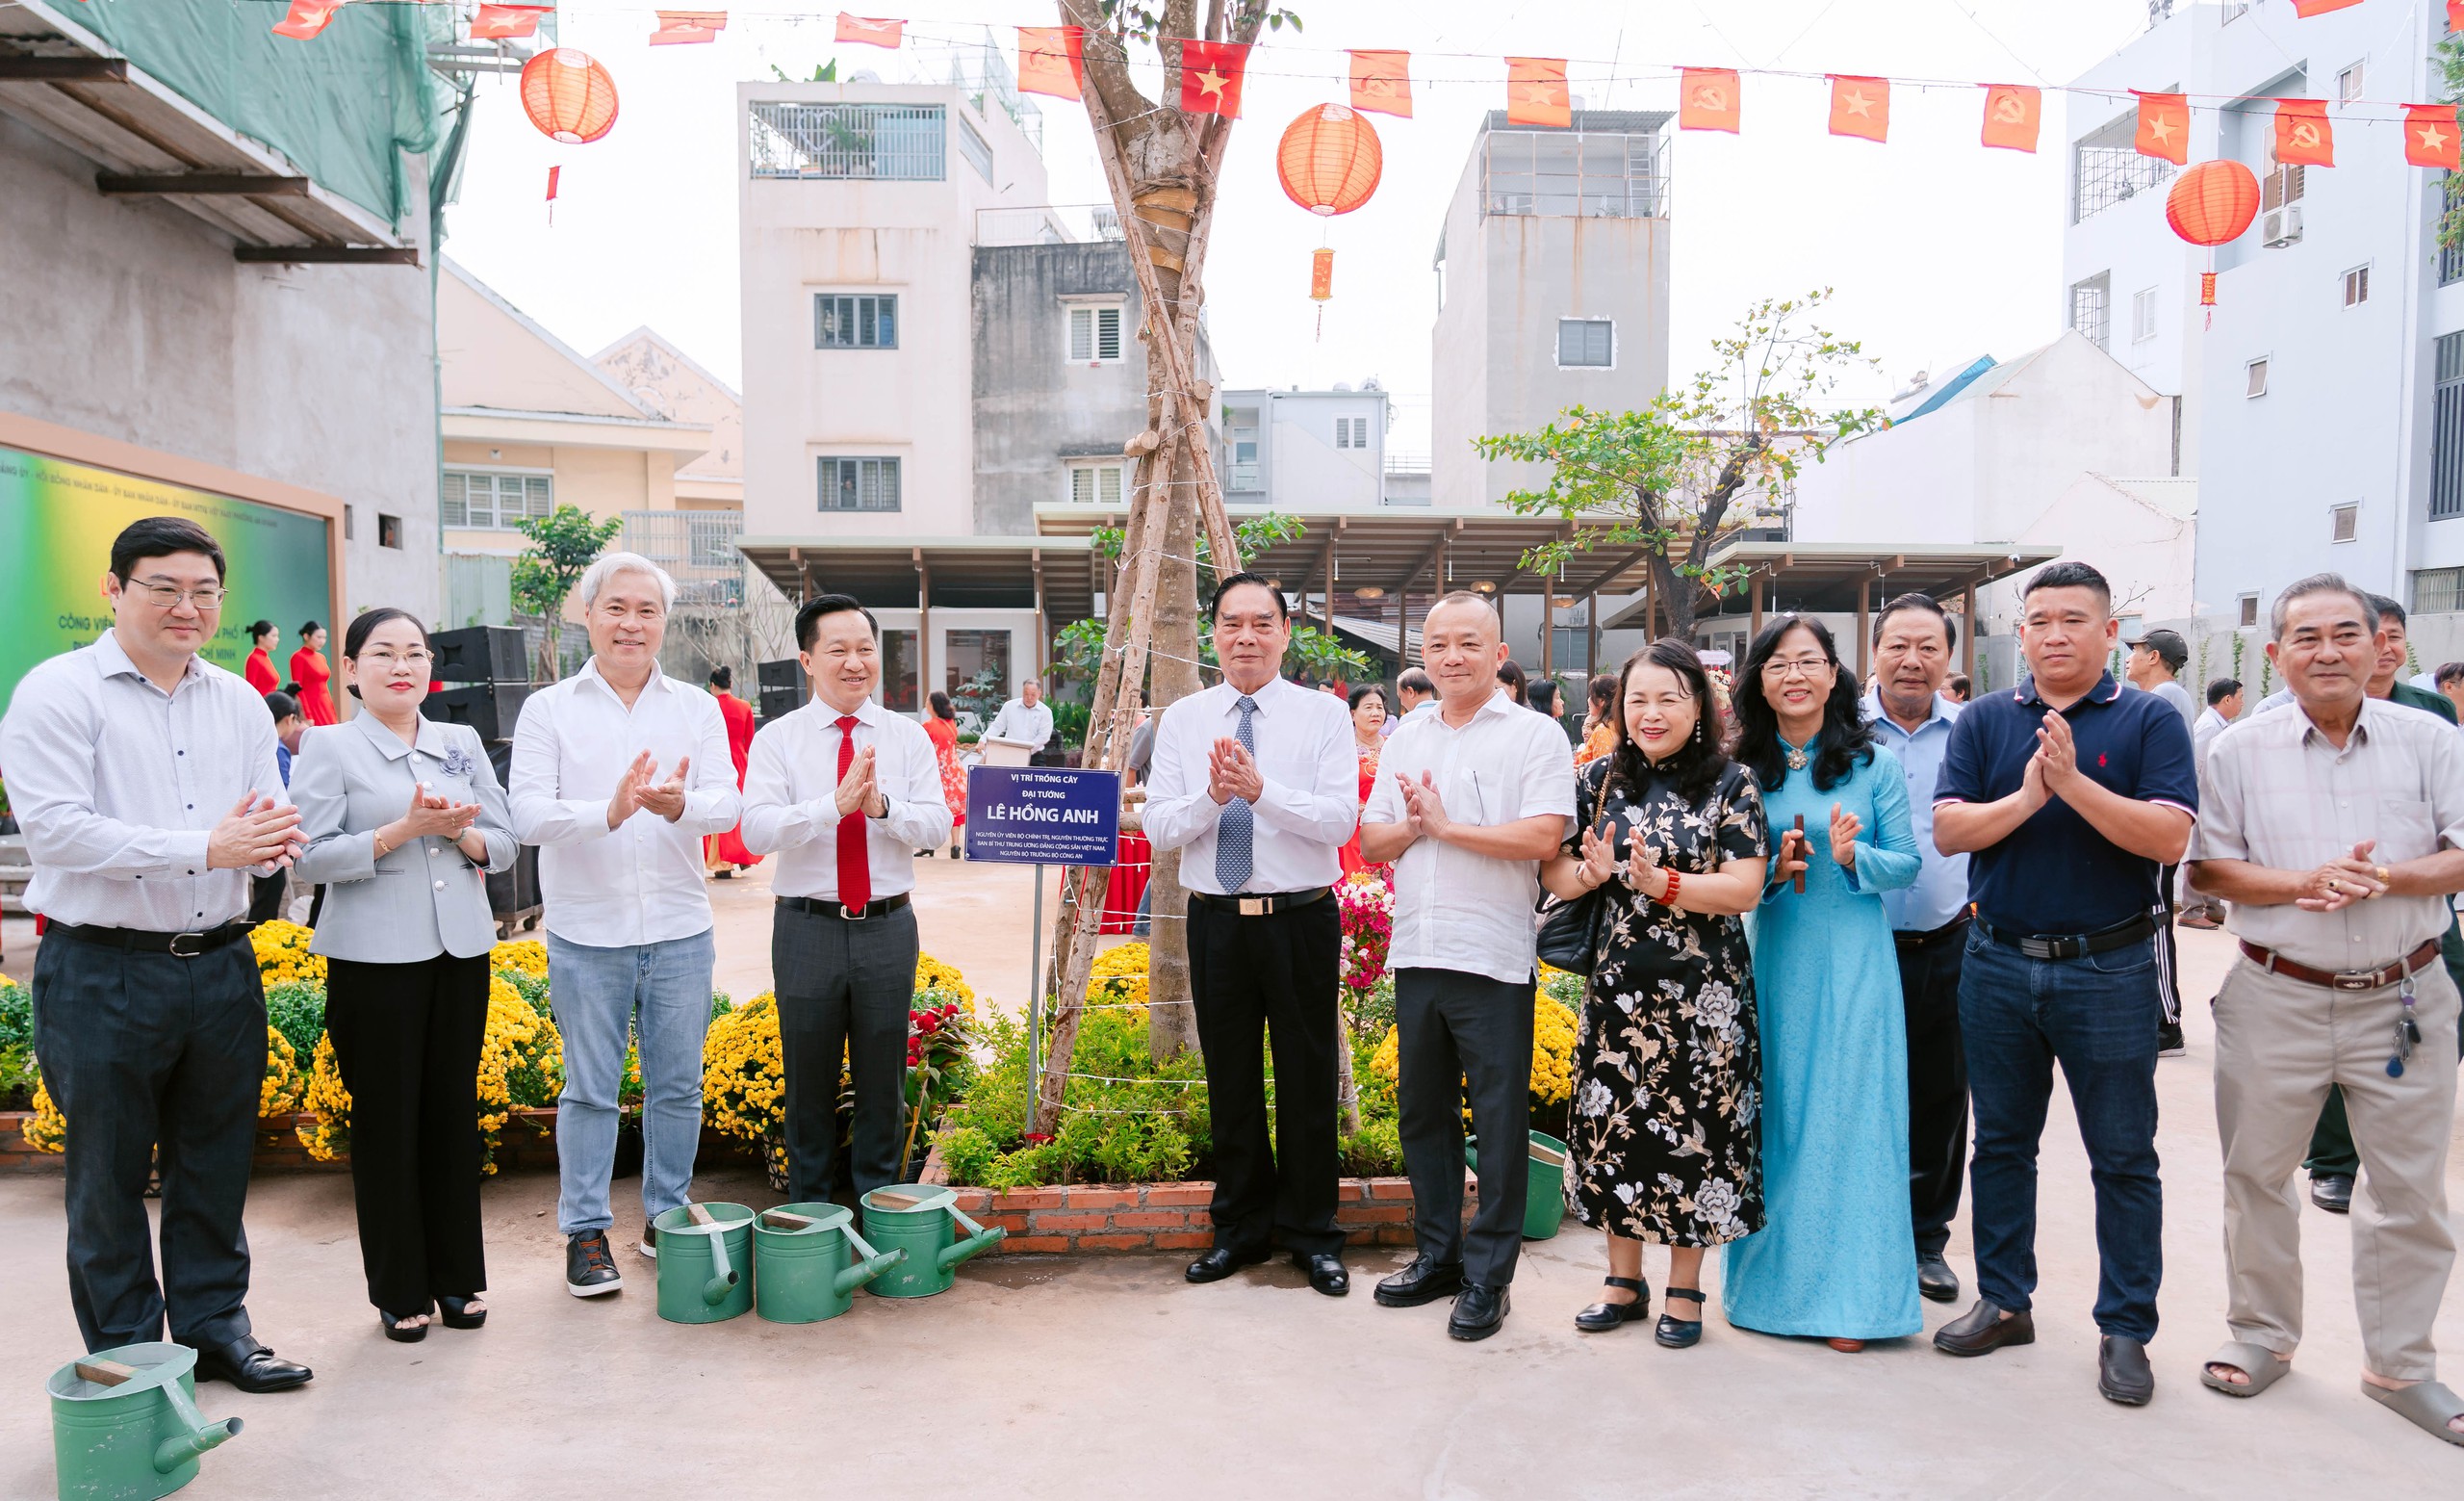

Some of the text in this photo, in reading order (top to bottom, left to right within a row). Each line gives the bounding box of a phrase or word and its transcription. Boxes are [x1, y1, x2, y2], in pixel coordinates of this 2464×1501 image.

[59, 613, 90, 631] CÔNG
[216, 648, 236, 660] MINH
[1011, 773, 1019, 783] VỊ
[1020, 773, 1033, 782] TRÍ
[1063, 775, 1078, 784] CÂY
[1021, 789, 1065, 799] ĐẠI TƯỚNG
[987, 802, 1099, 824] LÊ HỒNG ANH
